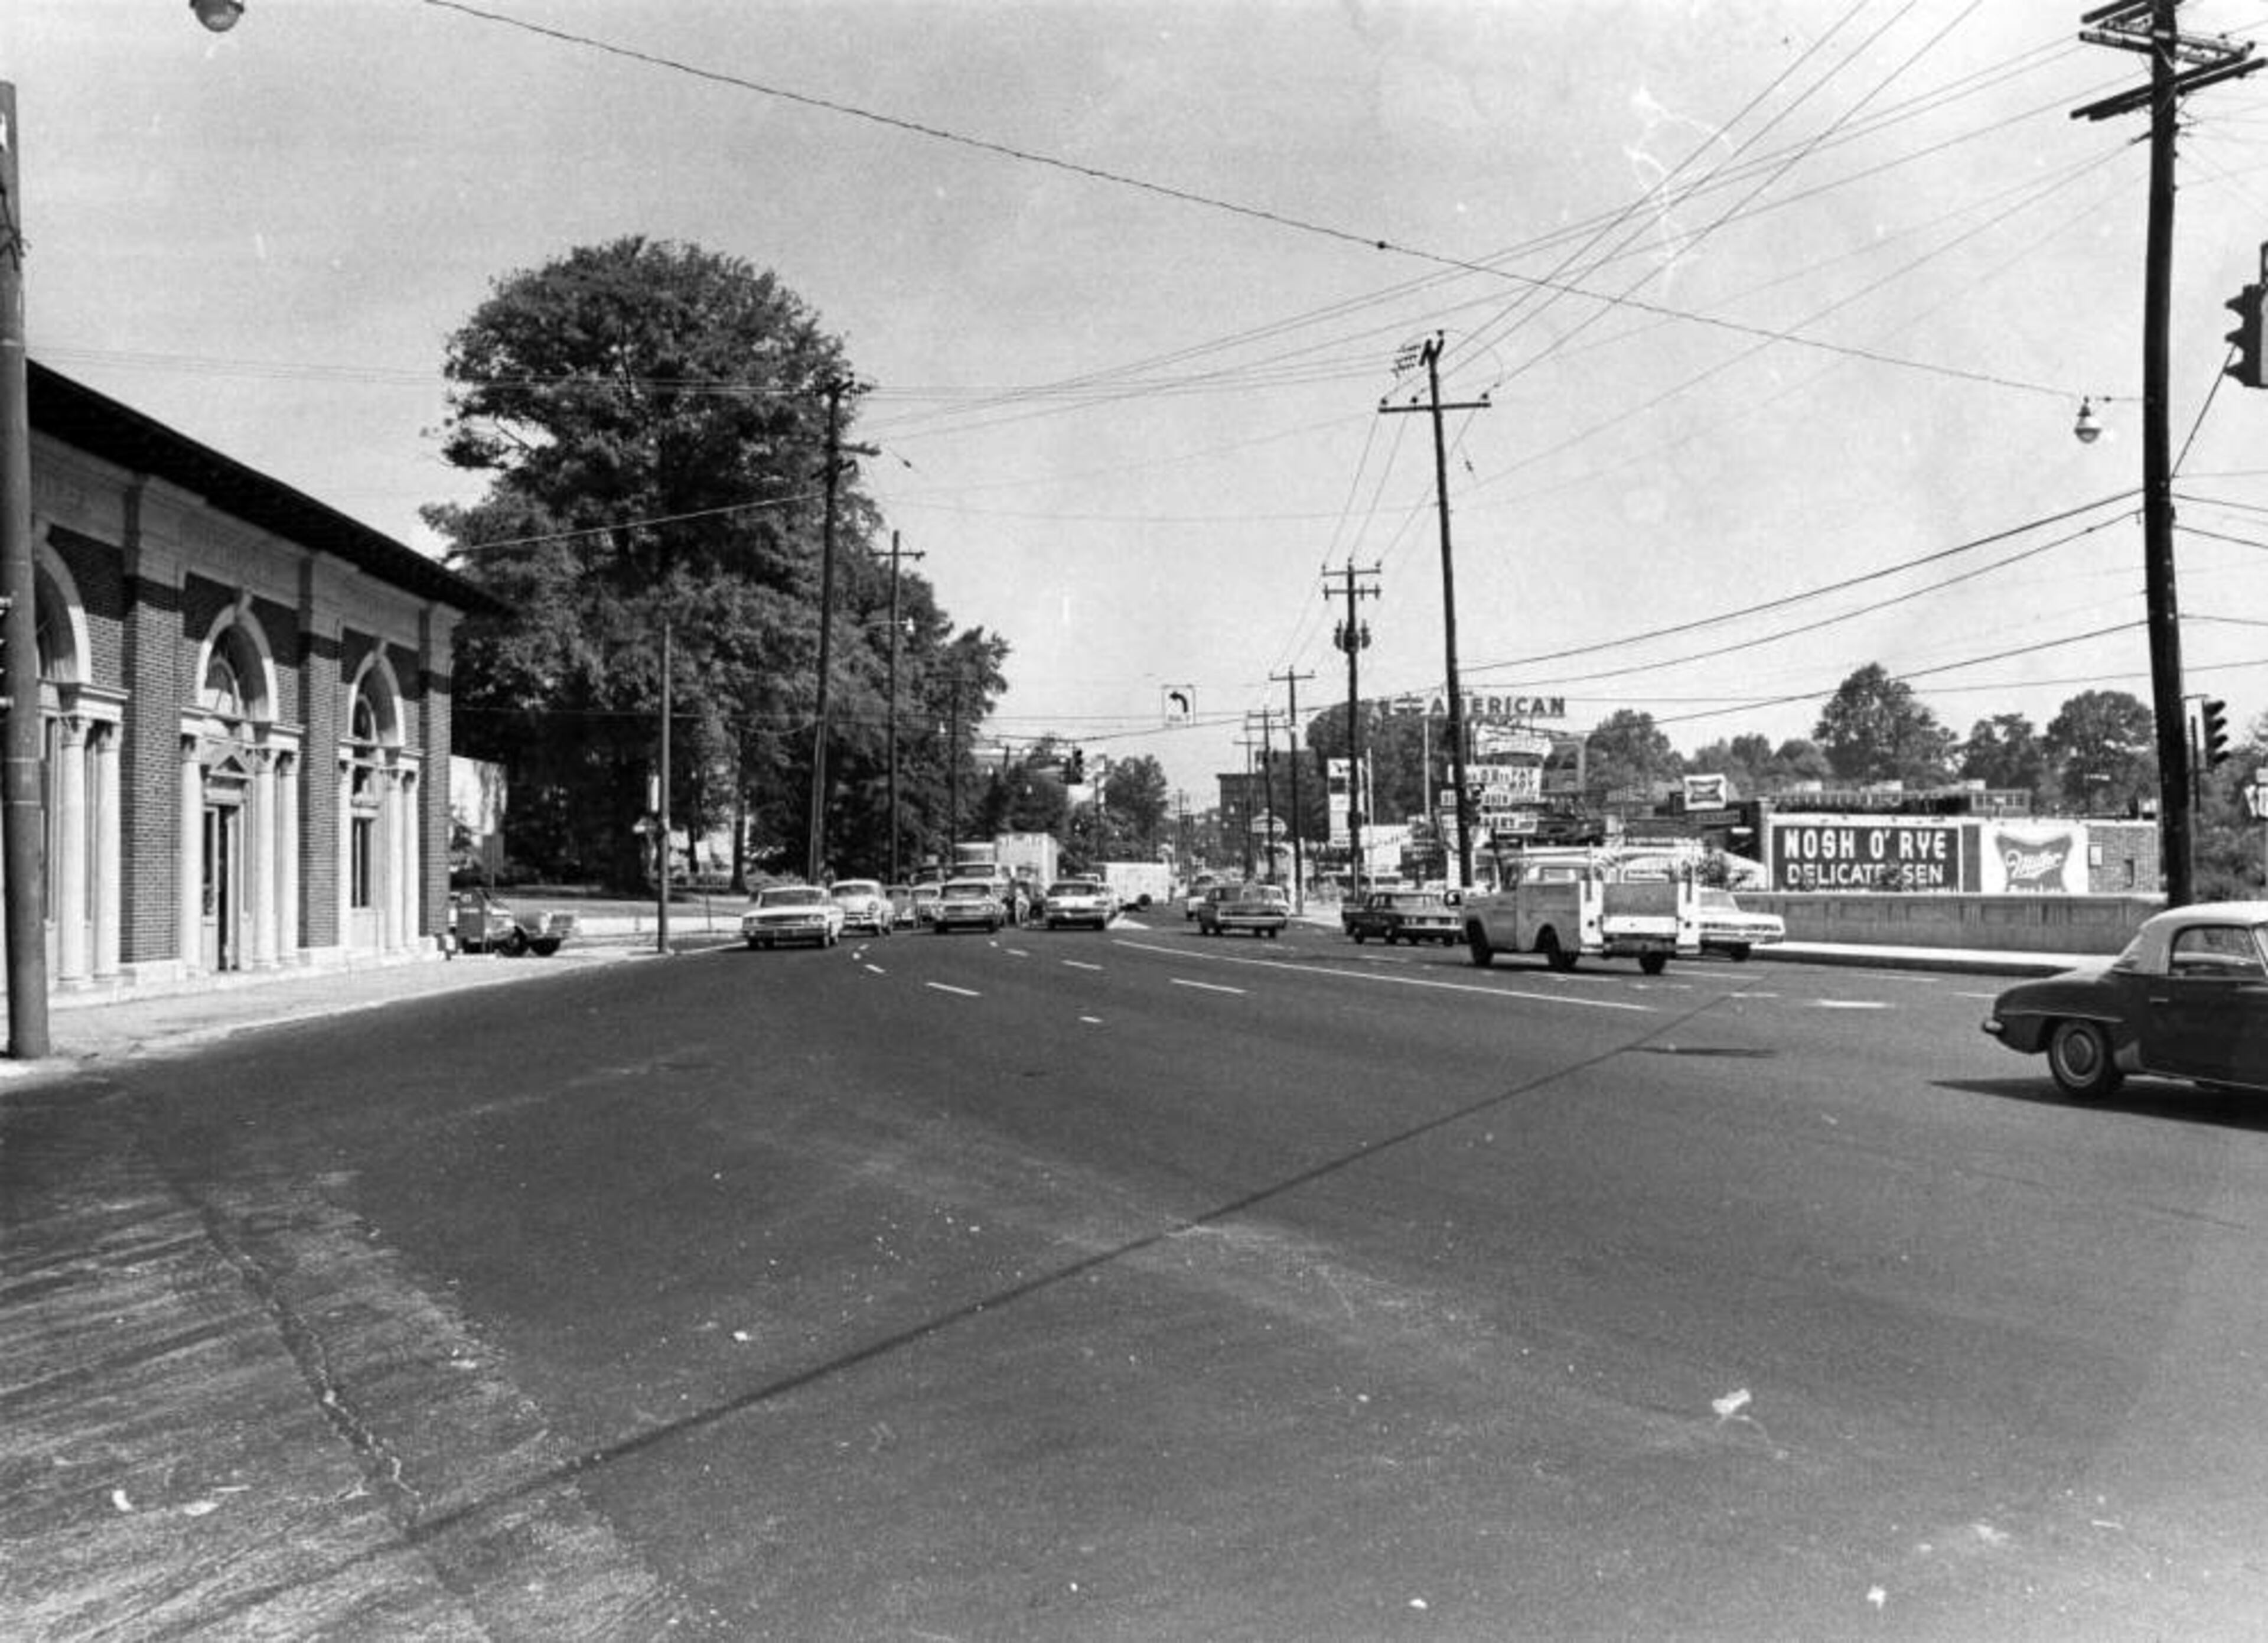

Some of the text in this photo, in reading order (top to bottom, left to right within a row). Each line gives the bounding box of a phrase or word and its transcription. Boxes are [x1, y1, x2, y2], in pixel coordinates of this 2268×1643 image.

[1431, 697, 1565, 714] AERICAN
[1784, 829, 1947, 860] NOSH O' RYE
[1787, 863, 1944, 885] DELICATESEN
